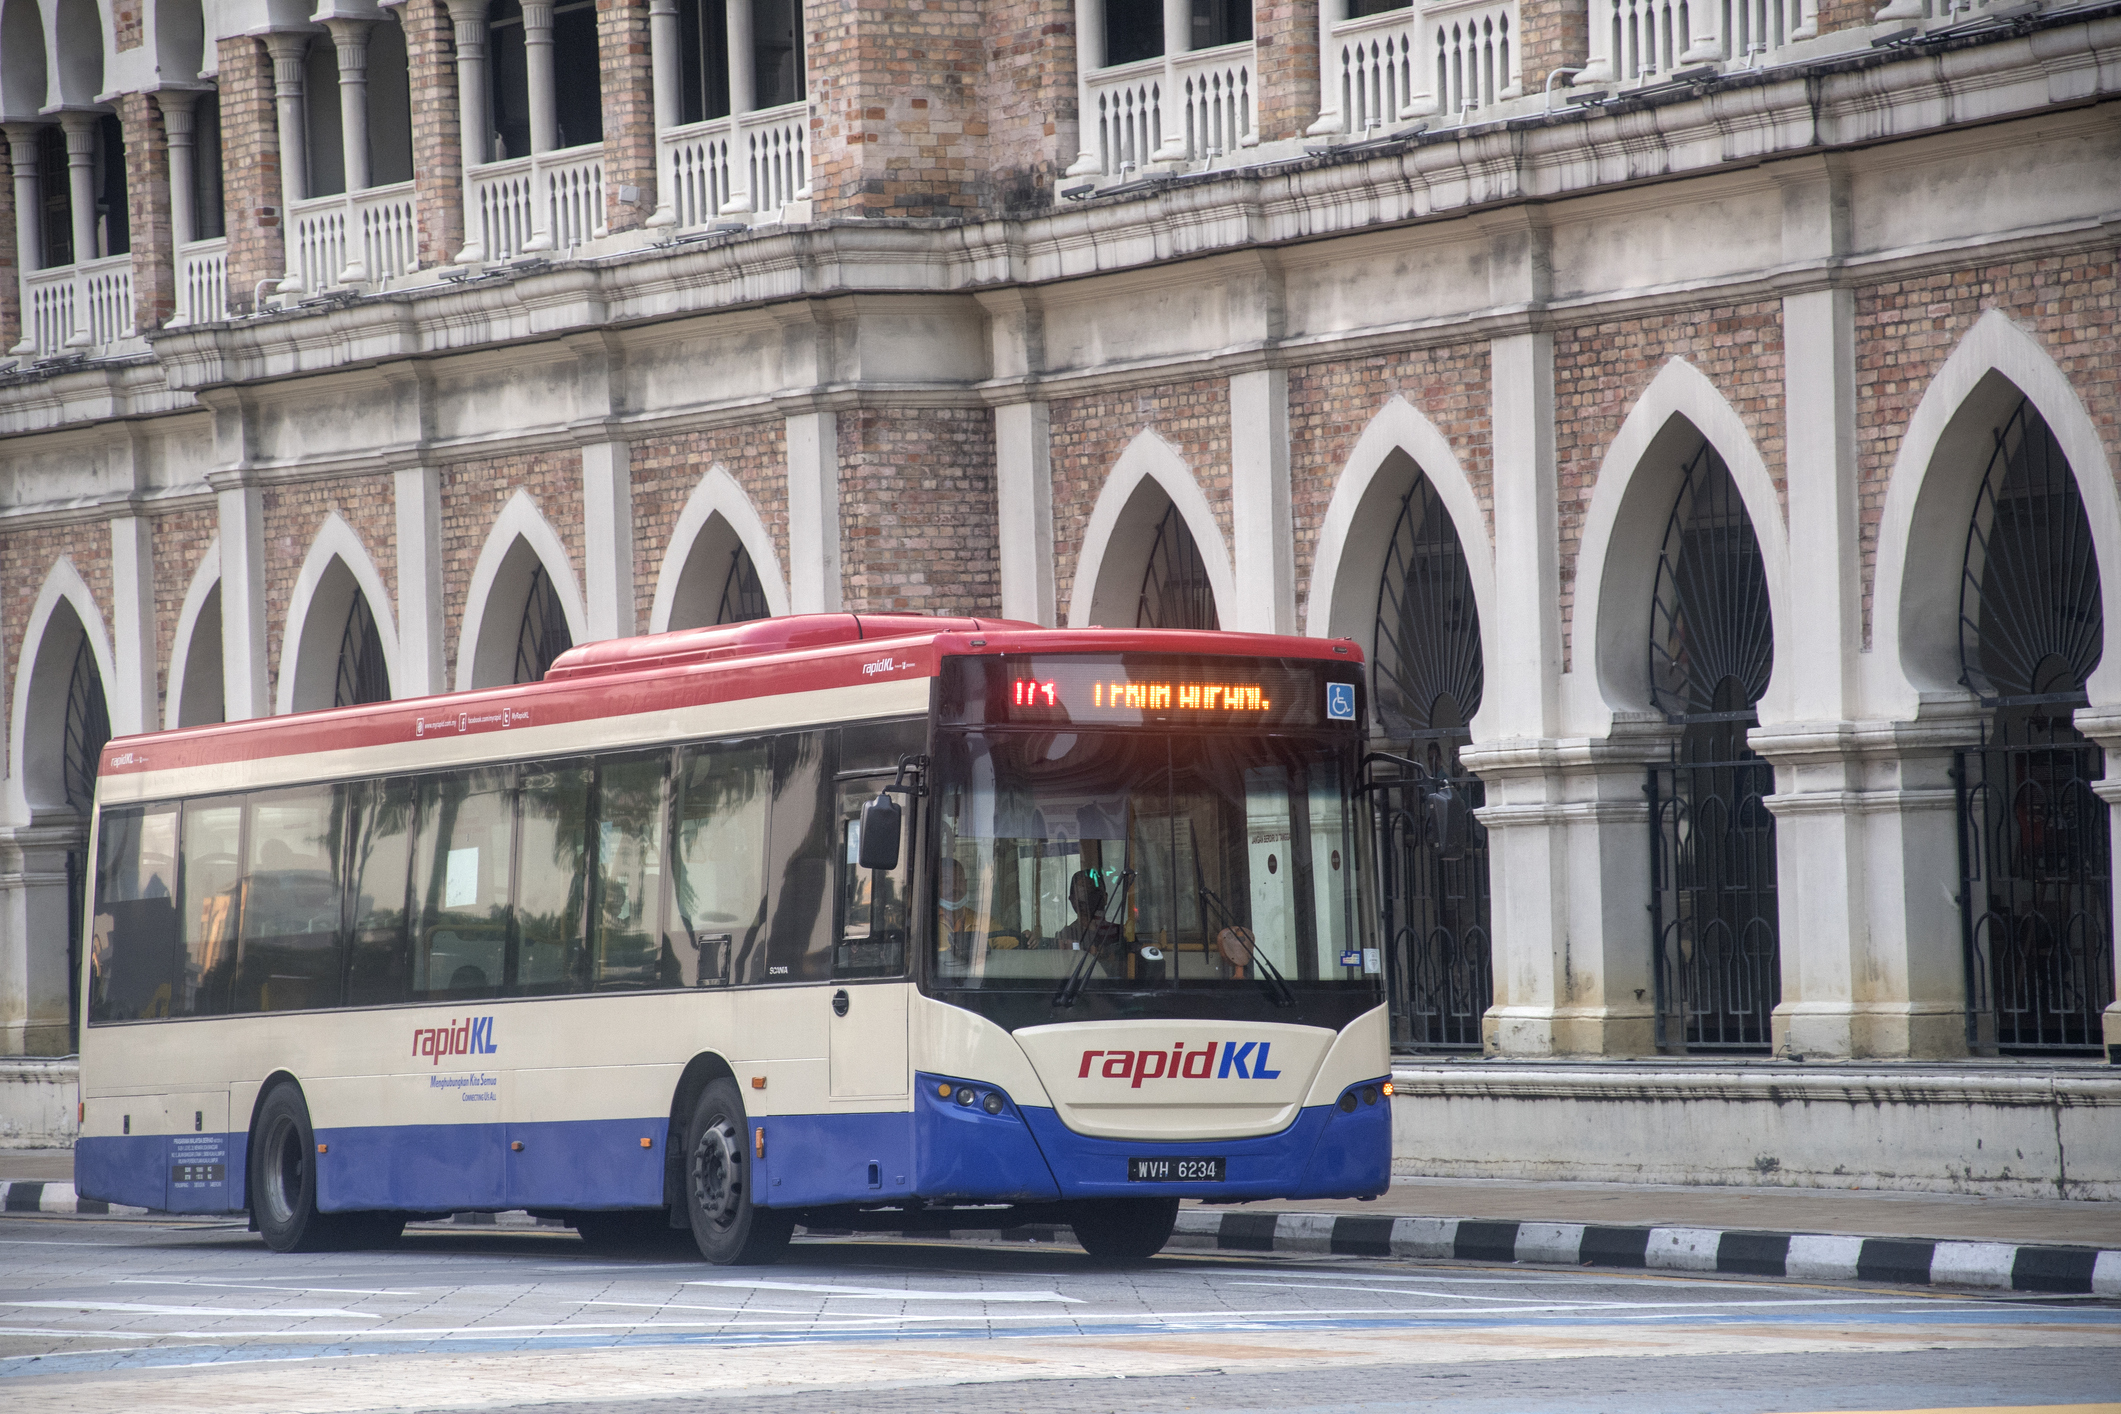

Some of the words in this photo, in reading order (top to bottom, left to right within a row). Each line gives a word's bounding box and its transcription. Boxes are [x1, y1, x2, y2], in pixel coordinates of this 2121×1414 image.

[862, 657, 894, 676] rapidKL
[769, 966, 788, 975] SCANIA
[412, 1016, 498, 1066] rapidKL
[1078, 1041, 1282, 1088] rapidKL
[430, 1075, 469, 1090] Menghubungkan
[470, 1073, 480, 1086] Kita
[480, 1073, 497, 1086] Semua
[1138, 1161, 1169, 1178] WVH
[1178, 1161, 1216, 1178] 6234
